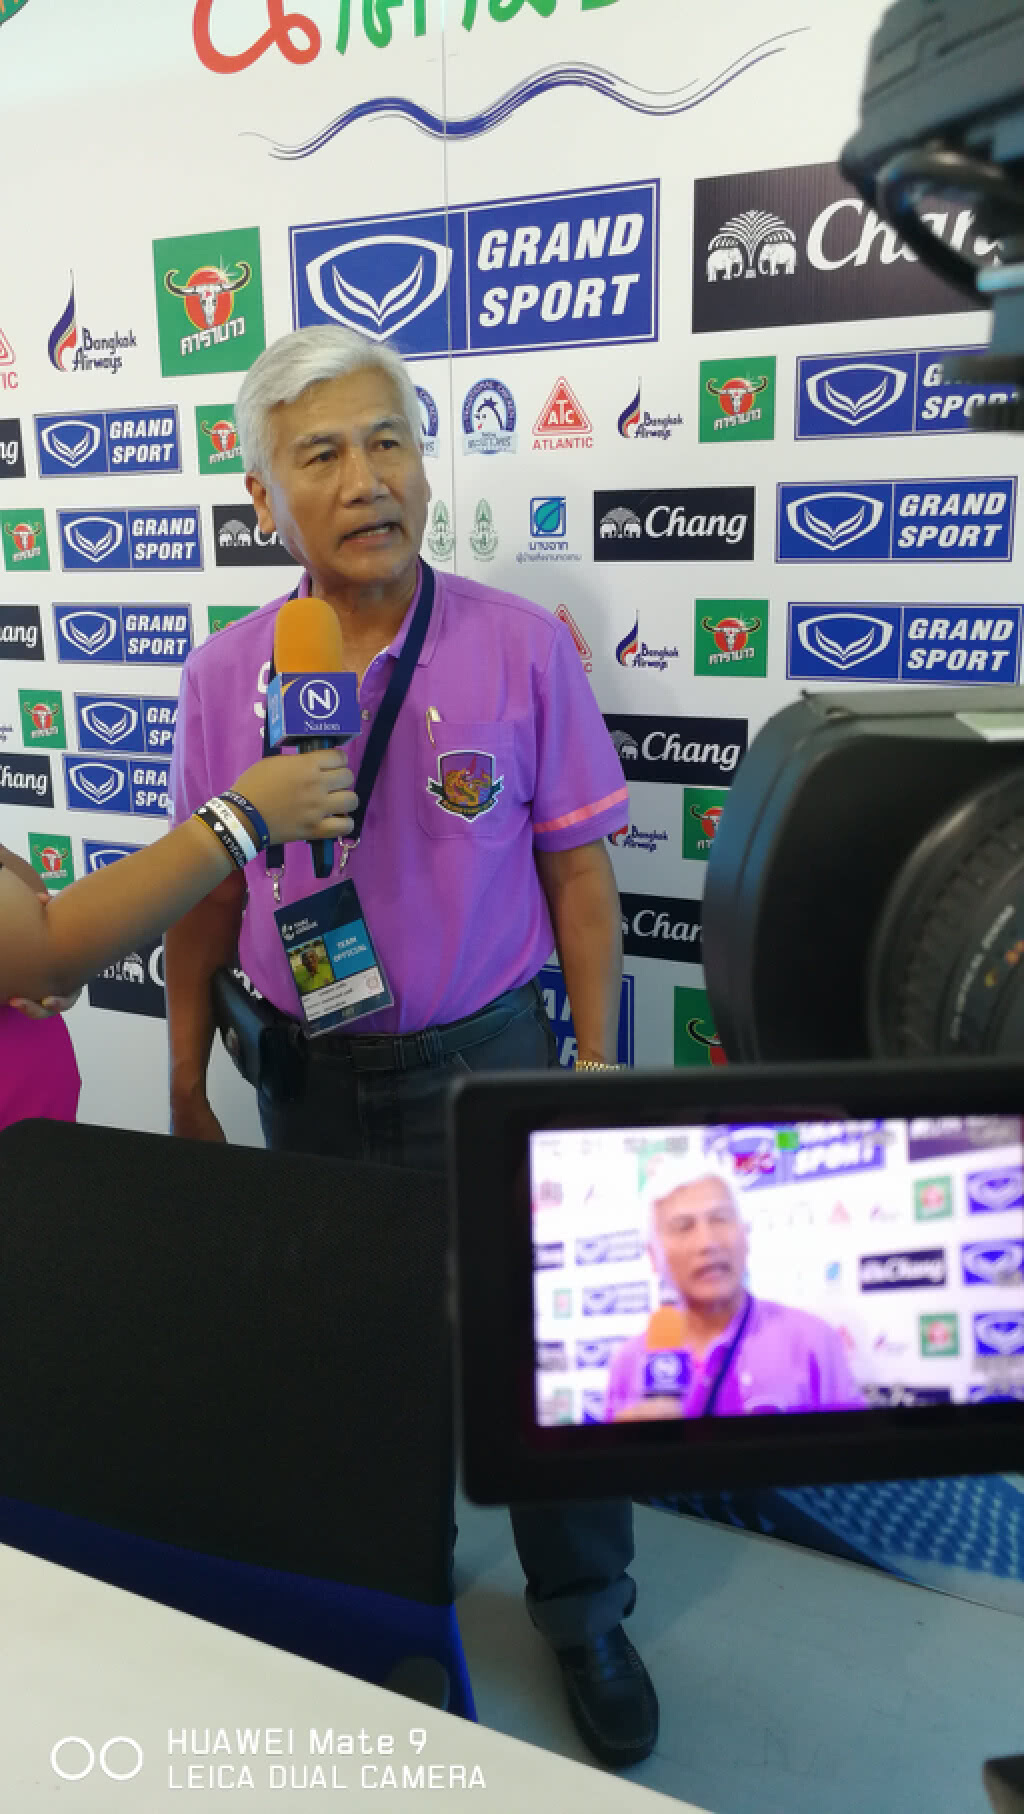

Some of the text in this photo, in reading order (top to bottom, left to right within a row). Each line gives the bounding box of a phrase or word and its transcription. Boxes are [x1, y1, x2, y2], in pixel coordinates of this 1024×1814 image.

[477, 212, 645, 272] GRAND
[478, 274, 640, 327] SPORT
[82, 327, 137, 355] Bangkok
[72, 347, 122, 374] Airways
[110, 418, 174, 439] GRAND
[112, 443, 174, 464] SPORT
[532, 437, 593, 450] ATLANTIC
[899, 492, 1007, 517] GRAND
[132, 518, 196, 536] GRAND
[645, 505, 747, 544] Chang
[898, 524, 1003, 548] SPORT
[134, 542, 196, 560] SPORT
[125, 614, 188, 632] GRAND
[907, 618, 1015, 642] GRAND
[0, 625, 37, 648] ang
[128, 637, 187, 655] SPORT
[907, 649, 1010, 672] SPORT
[307, 688, 331, 710] N
[304, 719, 341, 731] Nation
[642, 731, 741, 771] Chang
[0, 764, 47, 796] hang
[133, 769, 168, 787] GRA
[135, 790, 169, 808] SPO
